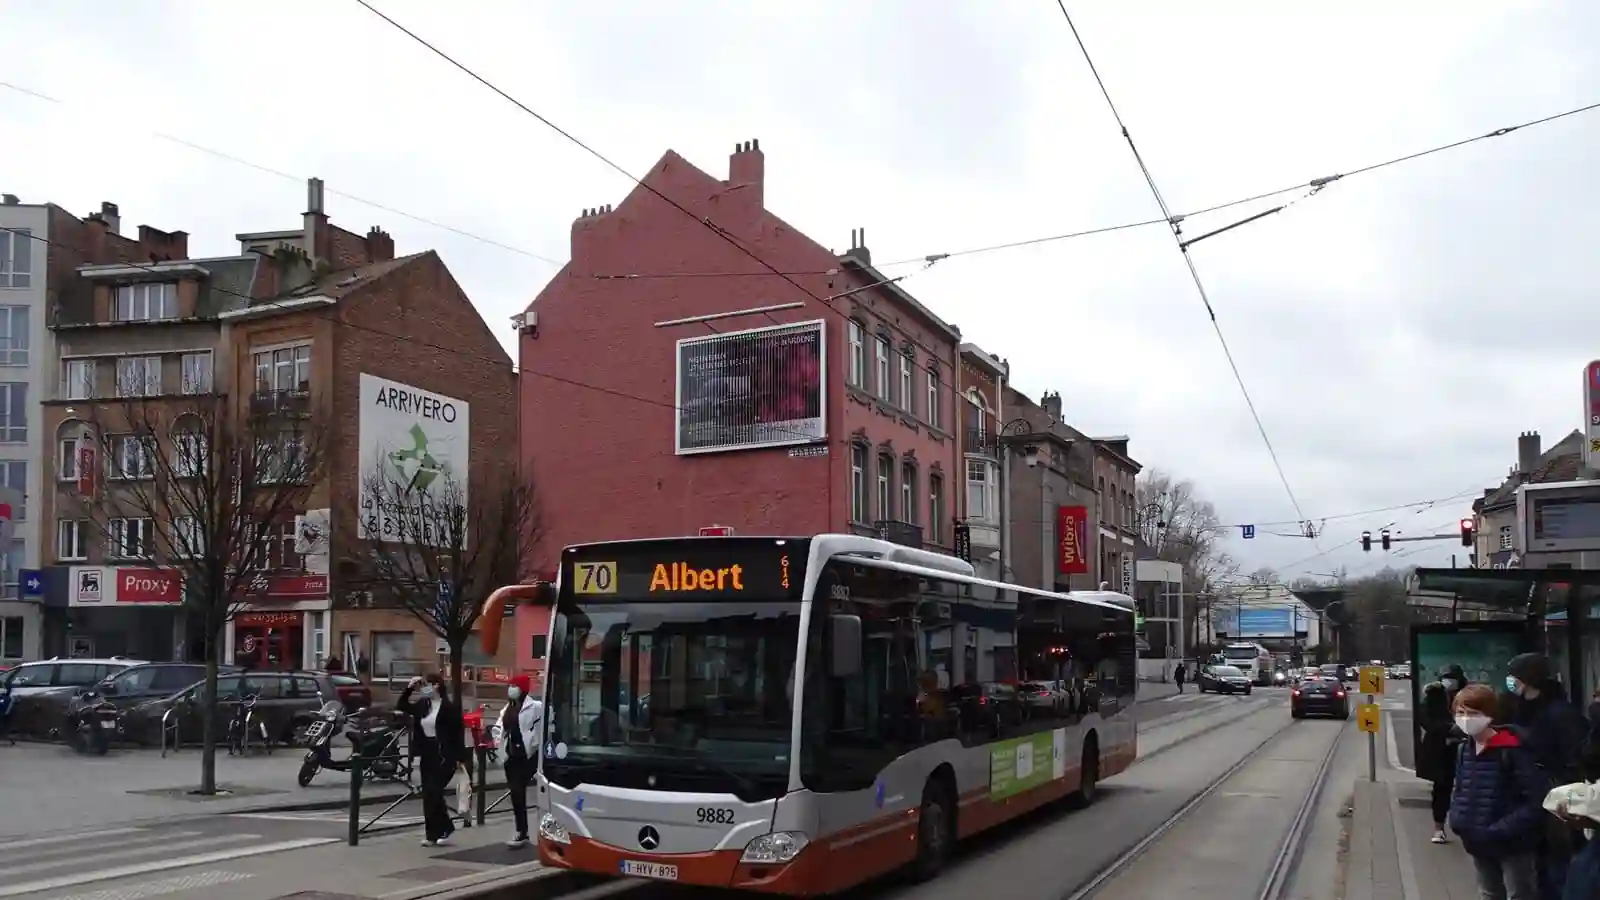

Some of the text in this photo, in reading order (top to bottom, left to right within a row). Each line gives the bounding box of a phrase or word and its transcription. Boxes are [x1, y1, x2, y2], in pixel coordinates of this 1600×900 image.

[1062, 514, 1075, 565] Wibra
[125, 574, 171, 596] Proxy
[578, 562, 744, 593] 70 Albert
[696, 807, 735, 825] 9882
